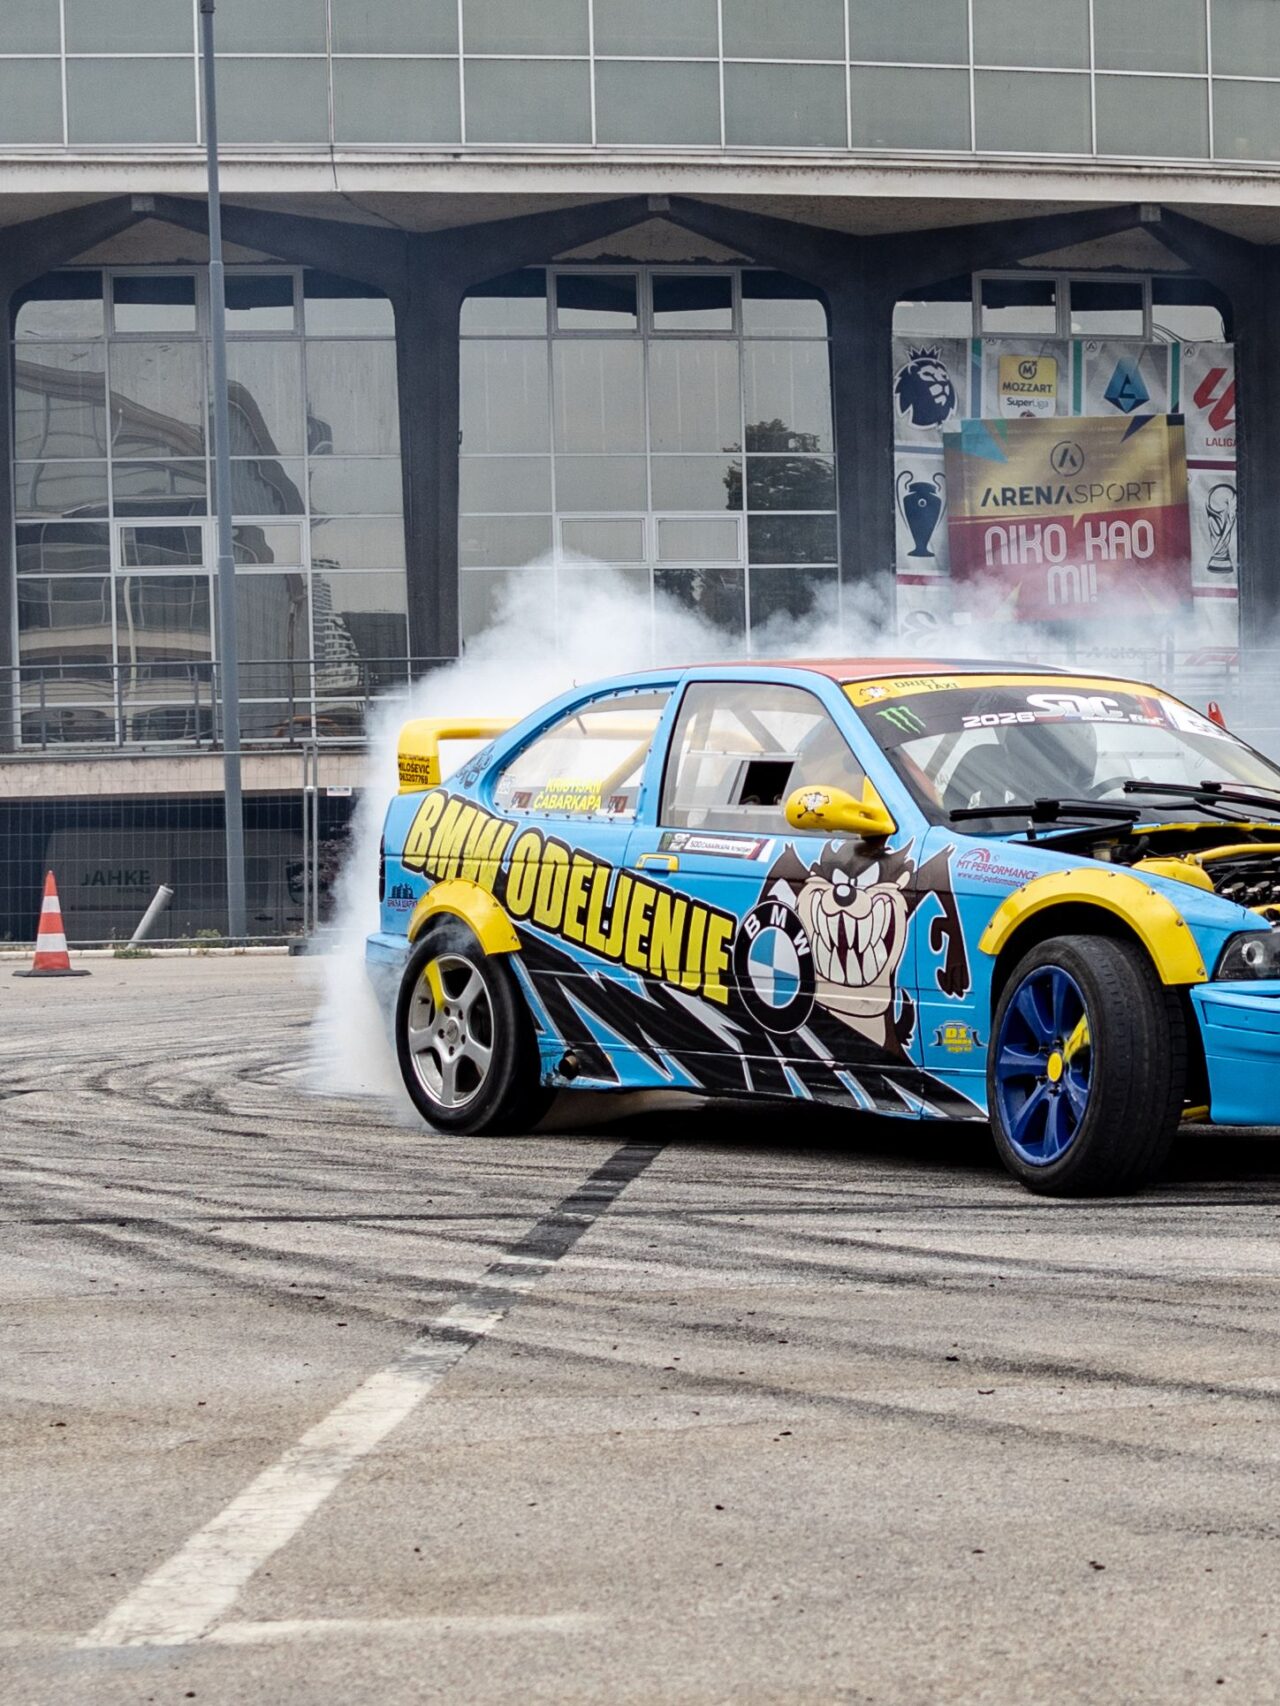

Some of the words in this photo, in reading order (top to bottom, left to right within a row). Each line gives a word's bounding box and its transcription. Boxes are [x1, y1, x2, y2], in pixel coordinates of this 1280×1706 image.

[1002, 382, 1053, 393] MOZZART
[984, 523, 1068, 567] NIKO
[1084, 519, 1155, 562] KAO
[1046, 564, 1098, 605] MI!
[927, 682, 959, 690] TAXI
[961, 711, 1036, 728] 2026
[533, 791, 602, 812] ČABARKAPA
[956, 859, 972, 869] MT
[970, 860, 1040, 880] PERFORMANCE
[404, 790, 516, 892] BMW
[505, 831, 735, 1006] ODELJENJE
[743, 904, 813, 957] BMW
